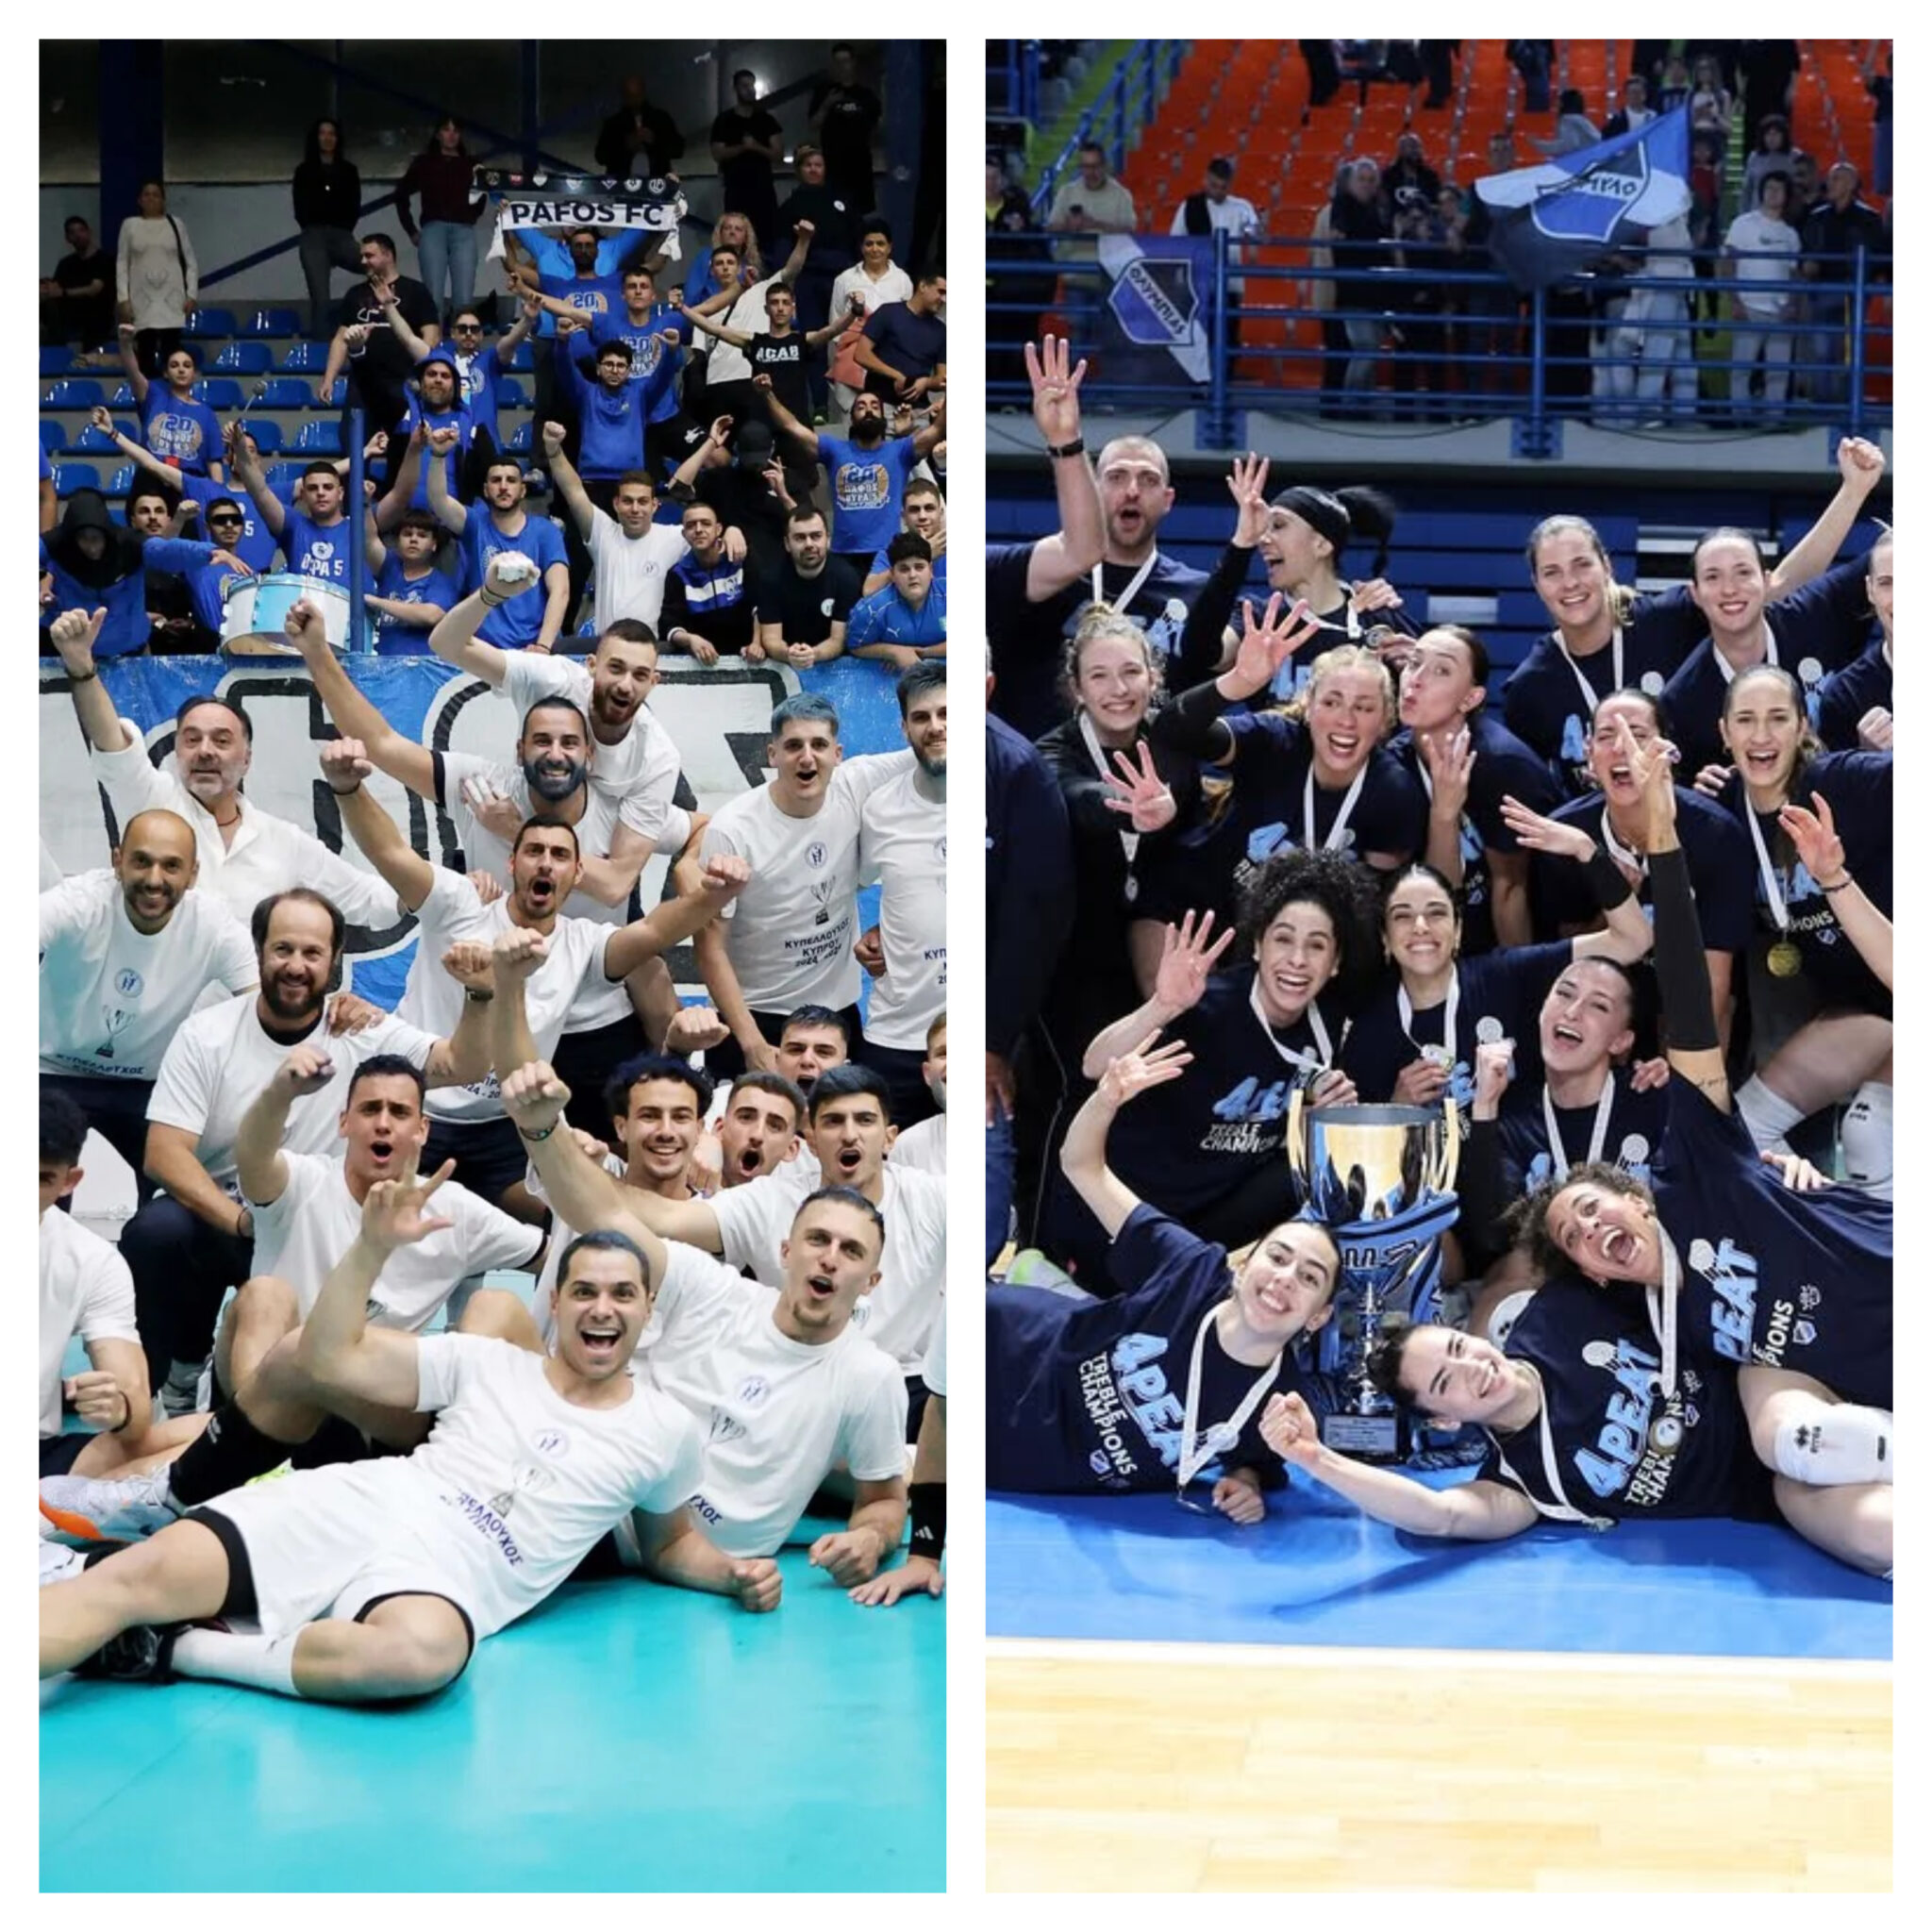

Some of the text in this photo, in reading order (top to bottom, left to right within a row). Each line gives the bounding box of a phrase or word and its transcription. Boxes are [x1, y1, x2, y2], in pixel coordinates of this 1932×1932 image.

[510, 202, 664, 225] PAFOS FC
[572, 291, 598, 309] 20
[163, 414, 194, 432] 20
[301, 553, 344, 577] ΘΡΑ 5
[802, 938, 840, 957] ΚΥΠΡΟΥ
[1710, 1235, 1757, 1363] PEAT
[1764, 1299, 1794, 1368] PIONS
[1093, 1351, 1128, 1423] TREBLE
[1078, 1359, 1139, 1476] CHAMPIONS
[1574, 1337, 1660, 1498] 4PEAT
